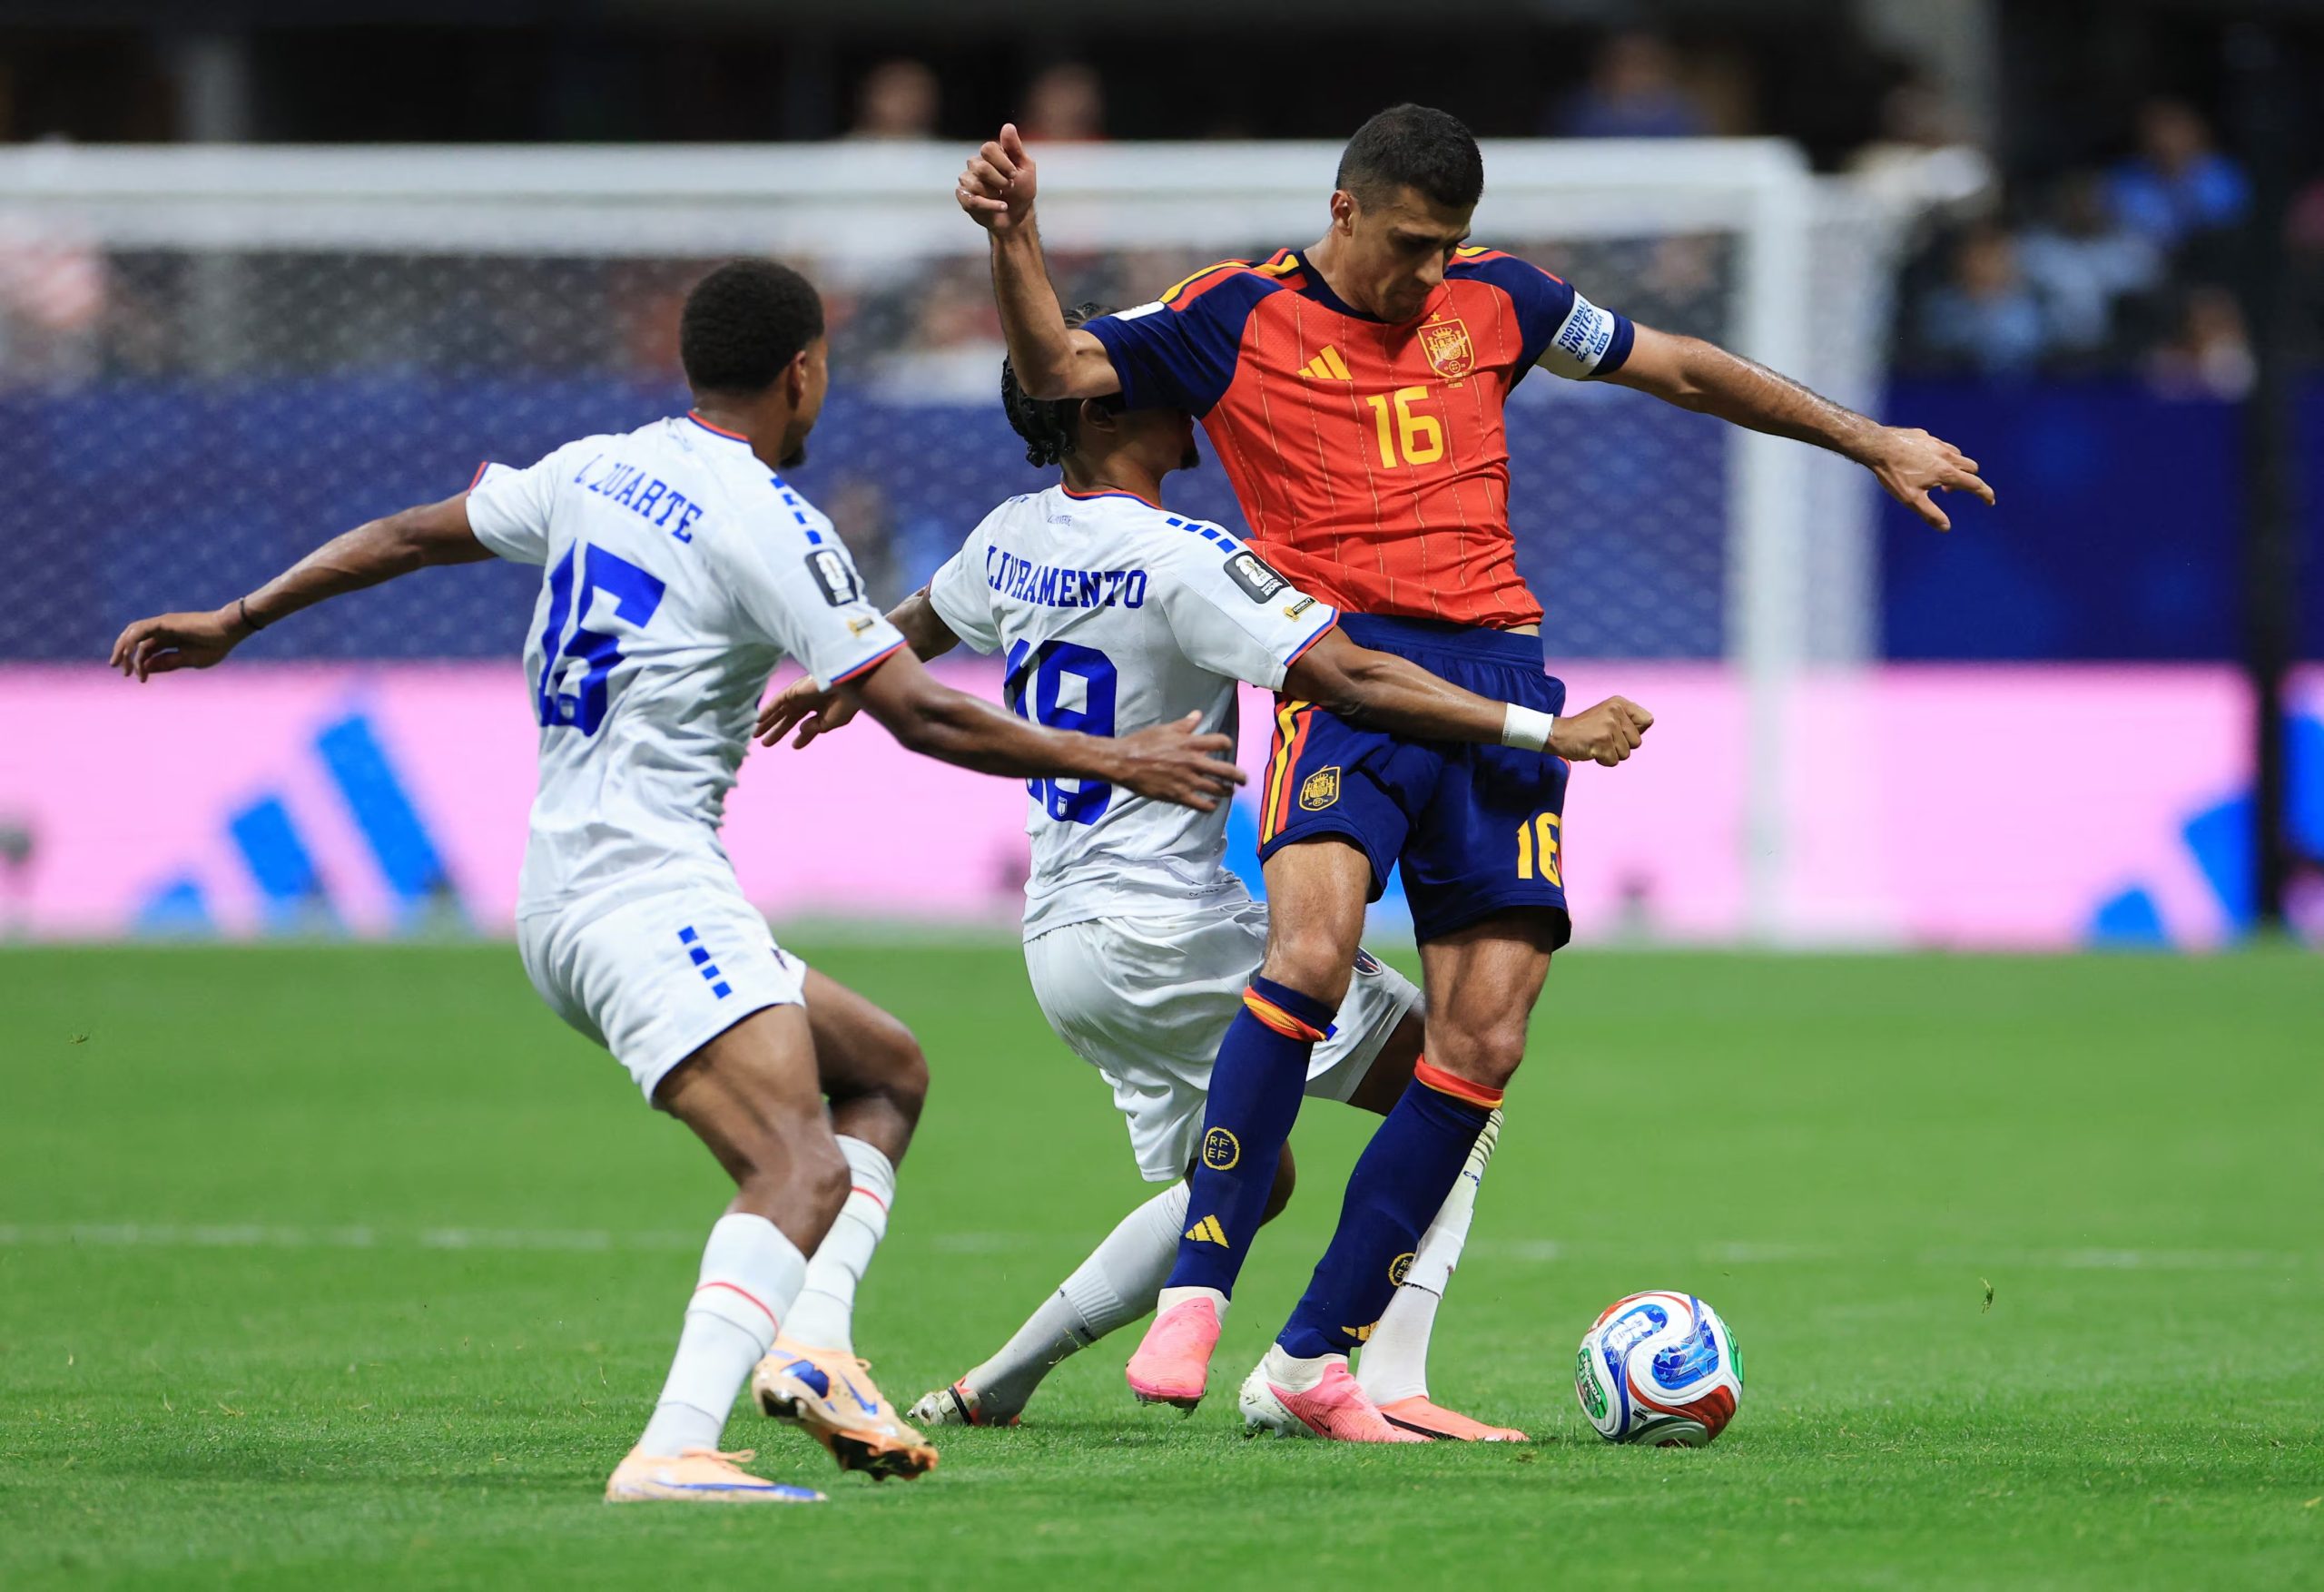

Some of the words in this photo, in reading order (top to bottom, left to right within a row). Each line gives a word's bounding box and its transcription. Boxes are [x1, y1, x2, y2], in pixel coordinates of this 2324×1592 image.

[1558, 300, 1586, 347] FOOTBALL
[1566, 305, 1594, 354] UNITES
[1594, 333, 1609, 355] FIFA
[1366, 385, 1443, 468] 16
[987, 545, 1147, 609] LIVRAMENTO
[1207, 1147, 1228, 1161] EF
[1210, 1135, 1230, 1148] RF
